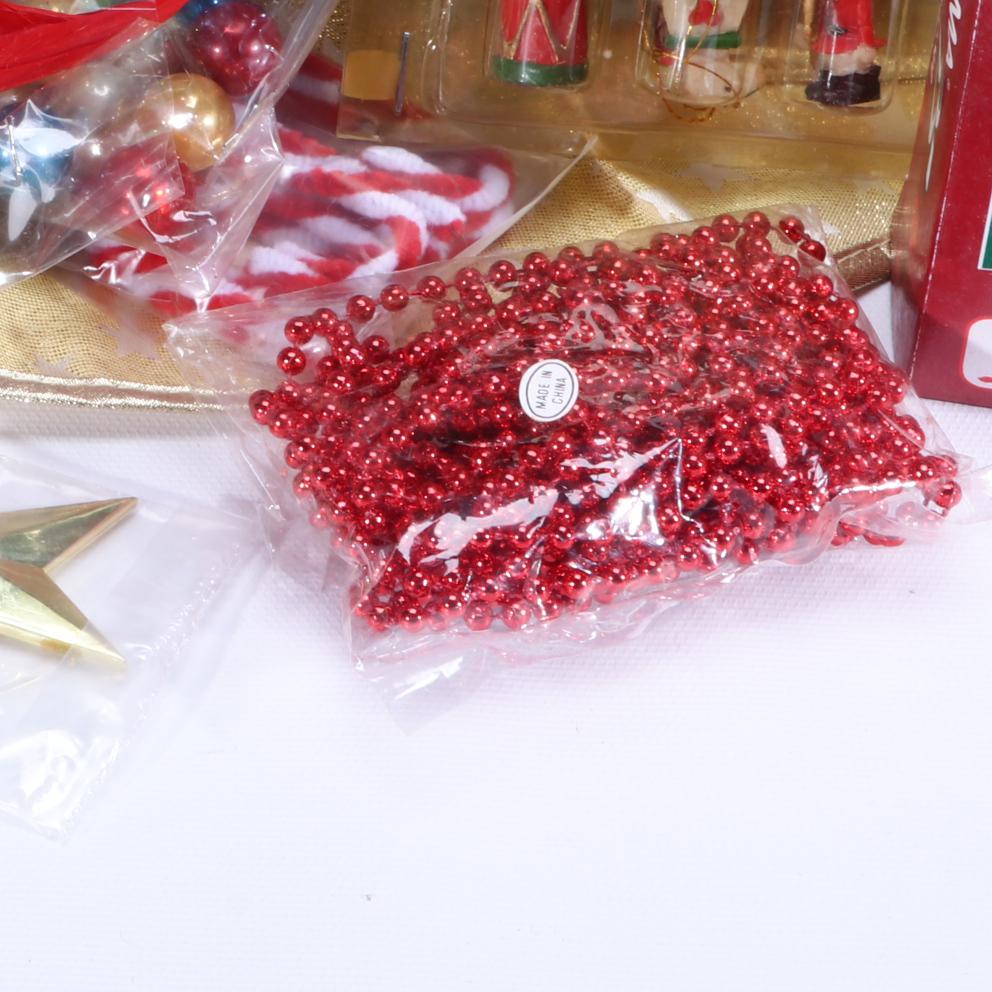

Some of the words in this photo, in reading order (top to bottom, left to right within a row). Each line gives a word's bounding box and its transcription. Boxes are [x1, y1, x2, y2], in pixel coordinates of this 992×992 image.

[541, 370, 553, 378] IN
[536, 384, 550, 409] MADE
[552, 377, 567, 405] CHINA
